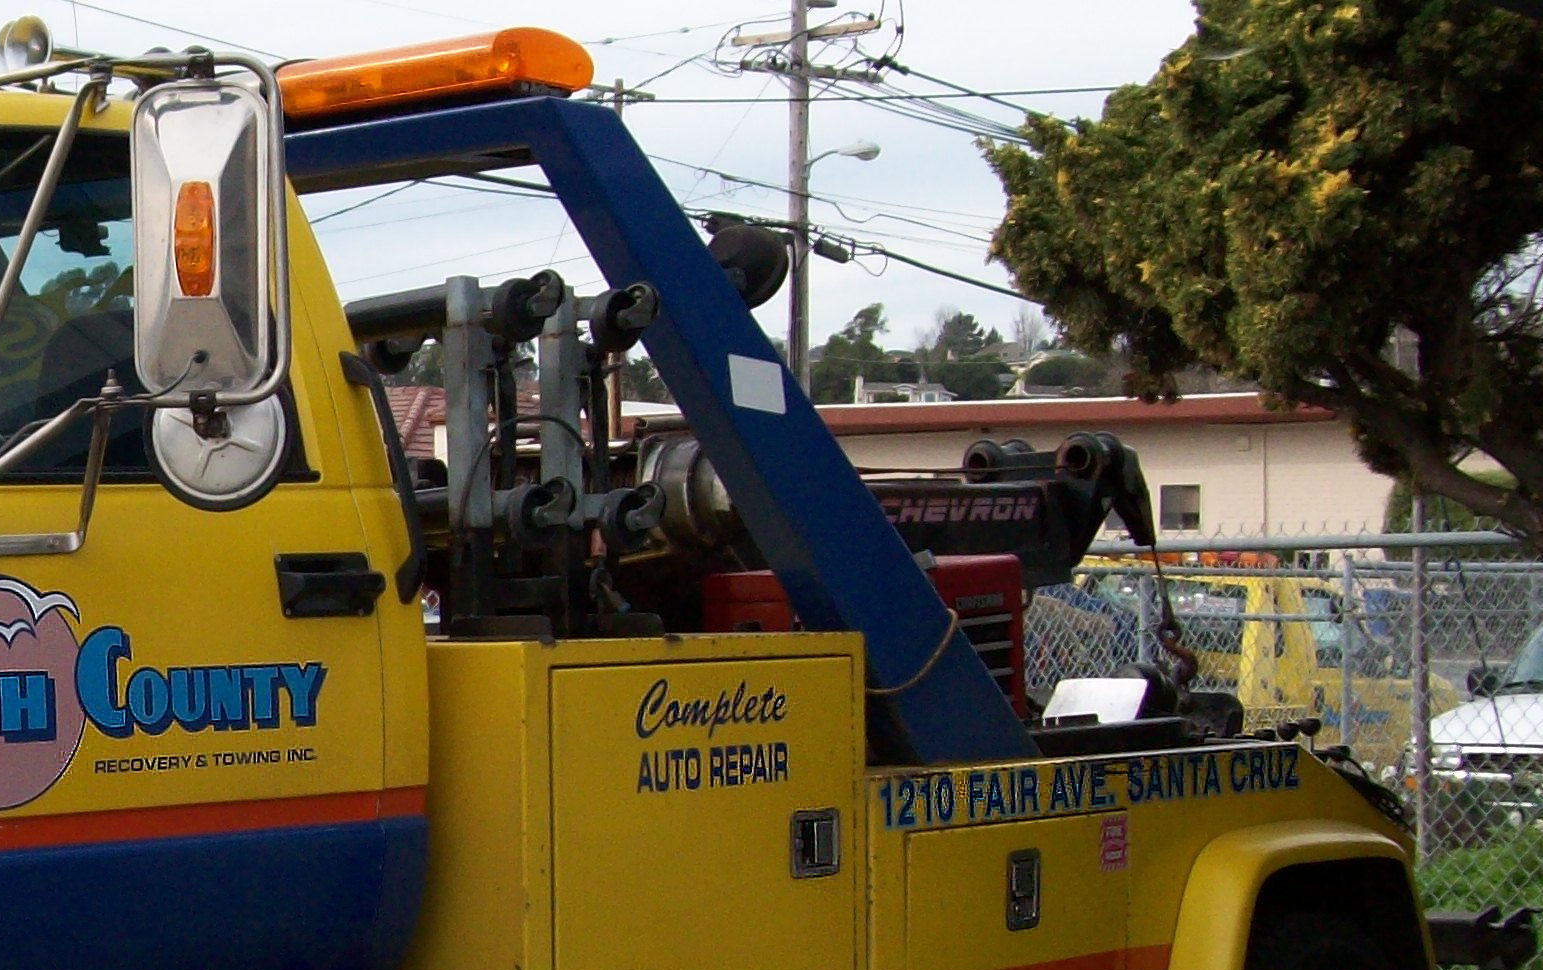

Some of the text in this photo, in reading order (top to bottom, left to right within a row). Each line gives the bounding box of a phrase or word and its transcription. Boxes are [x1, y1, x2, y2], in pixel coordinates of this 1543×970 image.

[74, 626, 329, 738] COUNTY
[635, 678, 789, 739] Complete
[94, 756, 193, 775] RECOVERY
[195, 754, 209, 769] &
[212, 750, 282, 767] TOWING
[636, 741, 789, 795] AUTO REPAIR
[879, 772, 956, 830] 1210
[967, 767, 1041, 821] FAIR
[1127, 752, 1222, 803] SANTA
[1229, 747, 1300, 792] CRUZ
